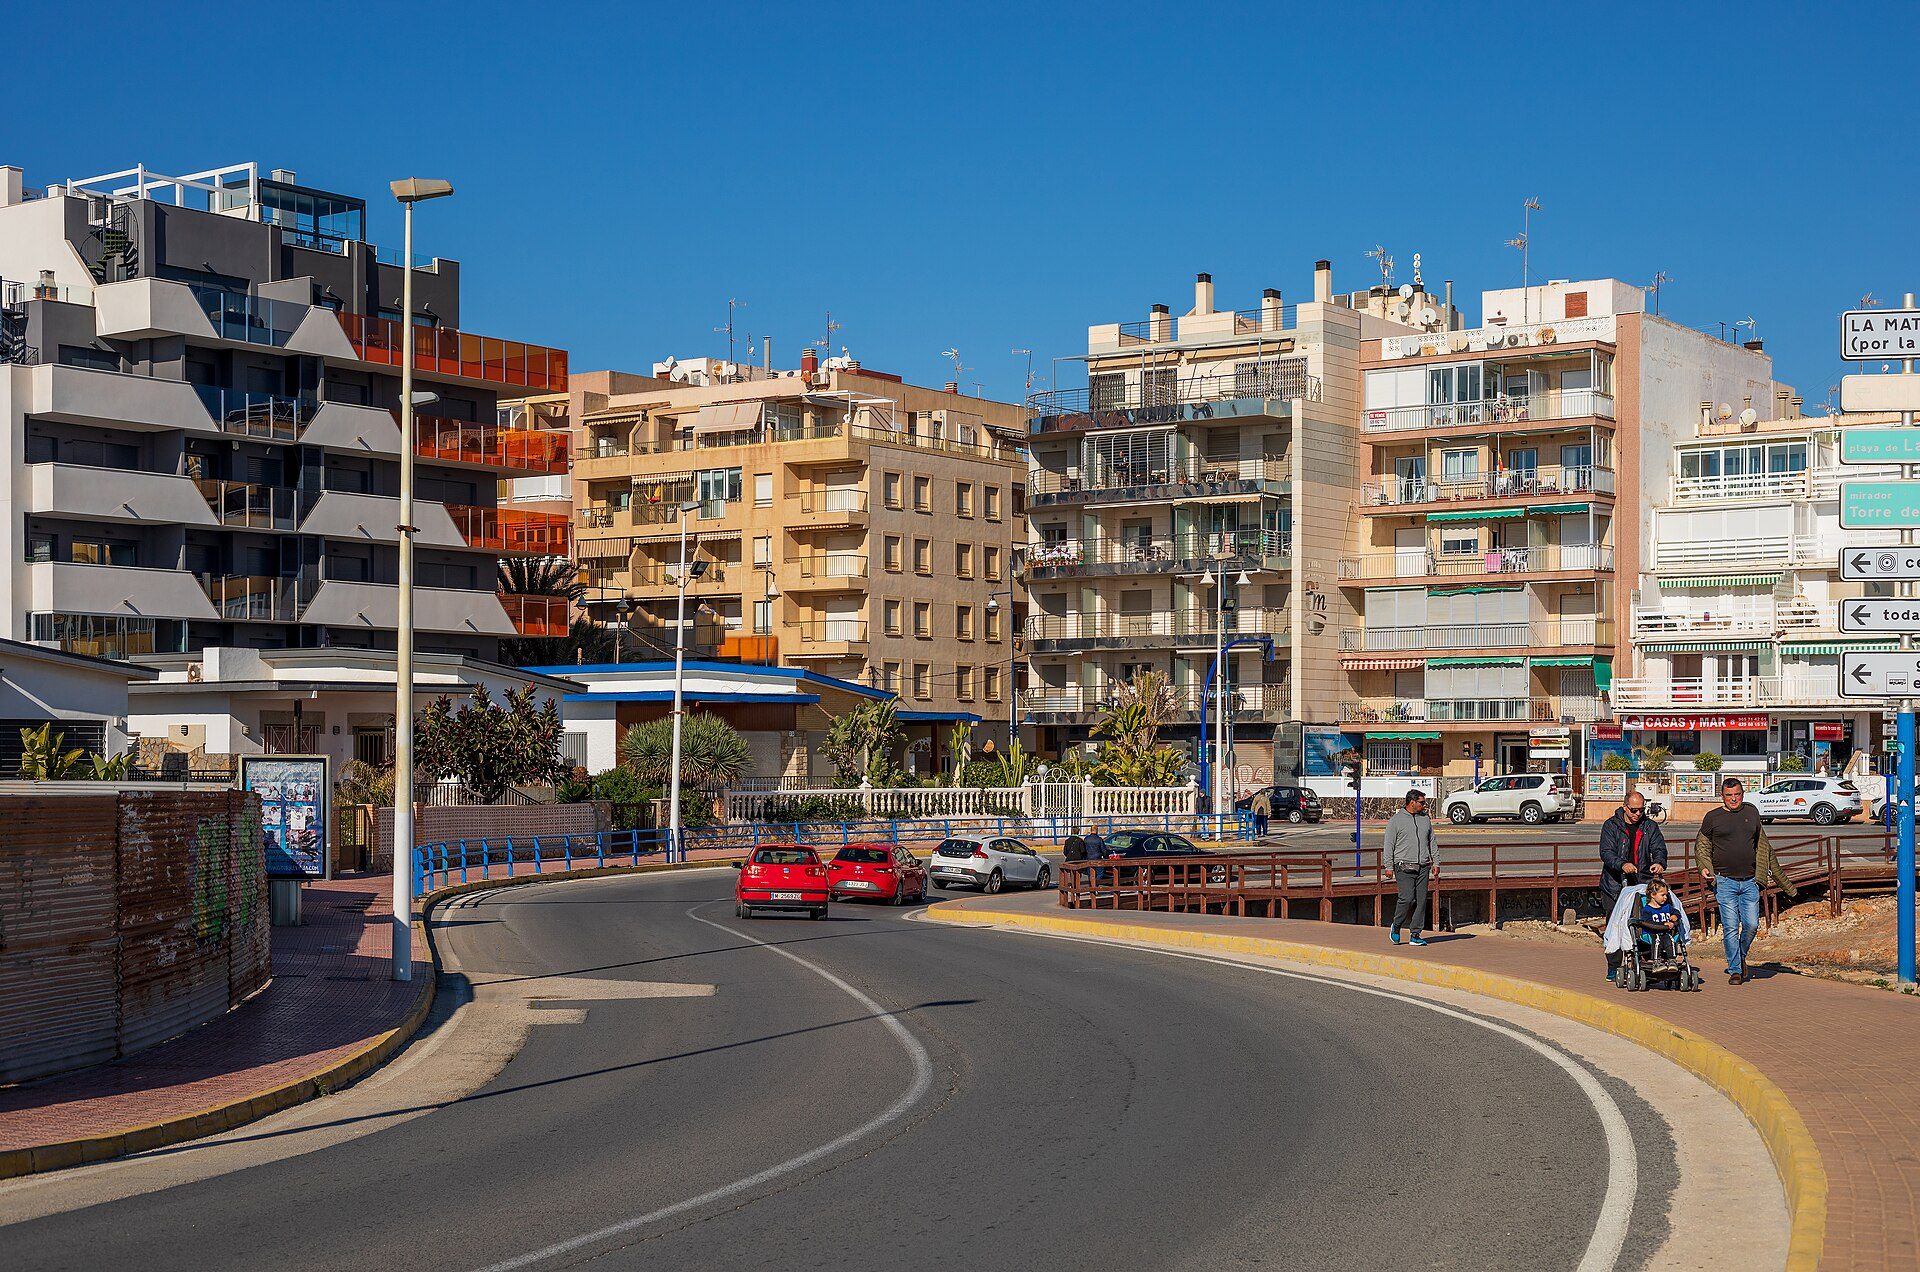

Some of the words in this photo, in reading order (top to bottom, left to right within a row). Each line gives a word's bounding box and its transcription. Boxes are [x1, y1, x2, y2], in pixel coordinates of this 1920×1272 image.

[1851, 319, 1874, 332] LA
[1884, 318, 1920, 331] MAT
[1851, 336, 1889, 353] (por
[1899, 336, 1915, 349] la
[1849, 444, 1880, 454] playa
[1885, 443, 1898, 452] de
[1849, 492, 1892, 500] mirador
[1849, 505, 1892, 518] Torre
[1900, 505, 1920, 518] de
[1883, 609, 1920, 621] toda
[1645, 717, 1686, 728] CASAS
[1689, 719, 1696, 730] y
[1700, 717, 1727, 728] MAR
